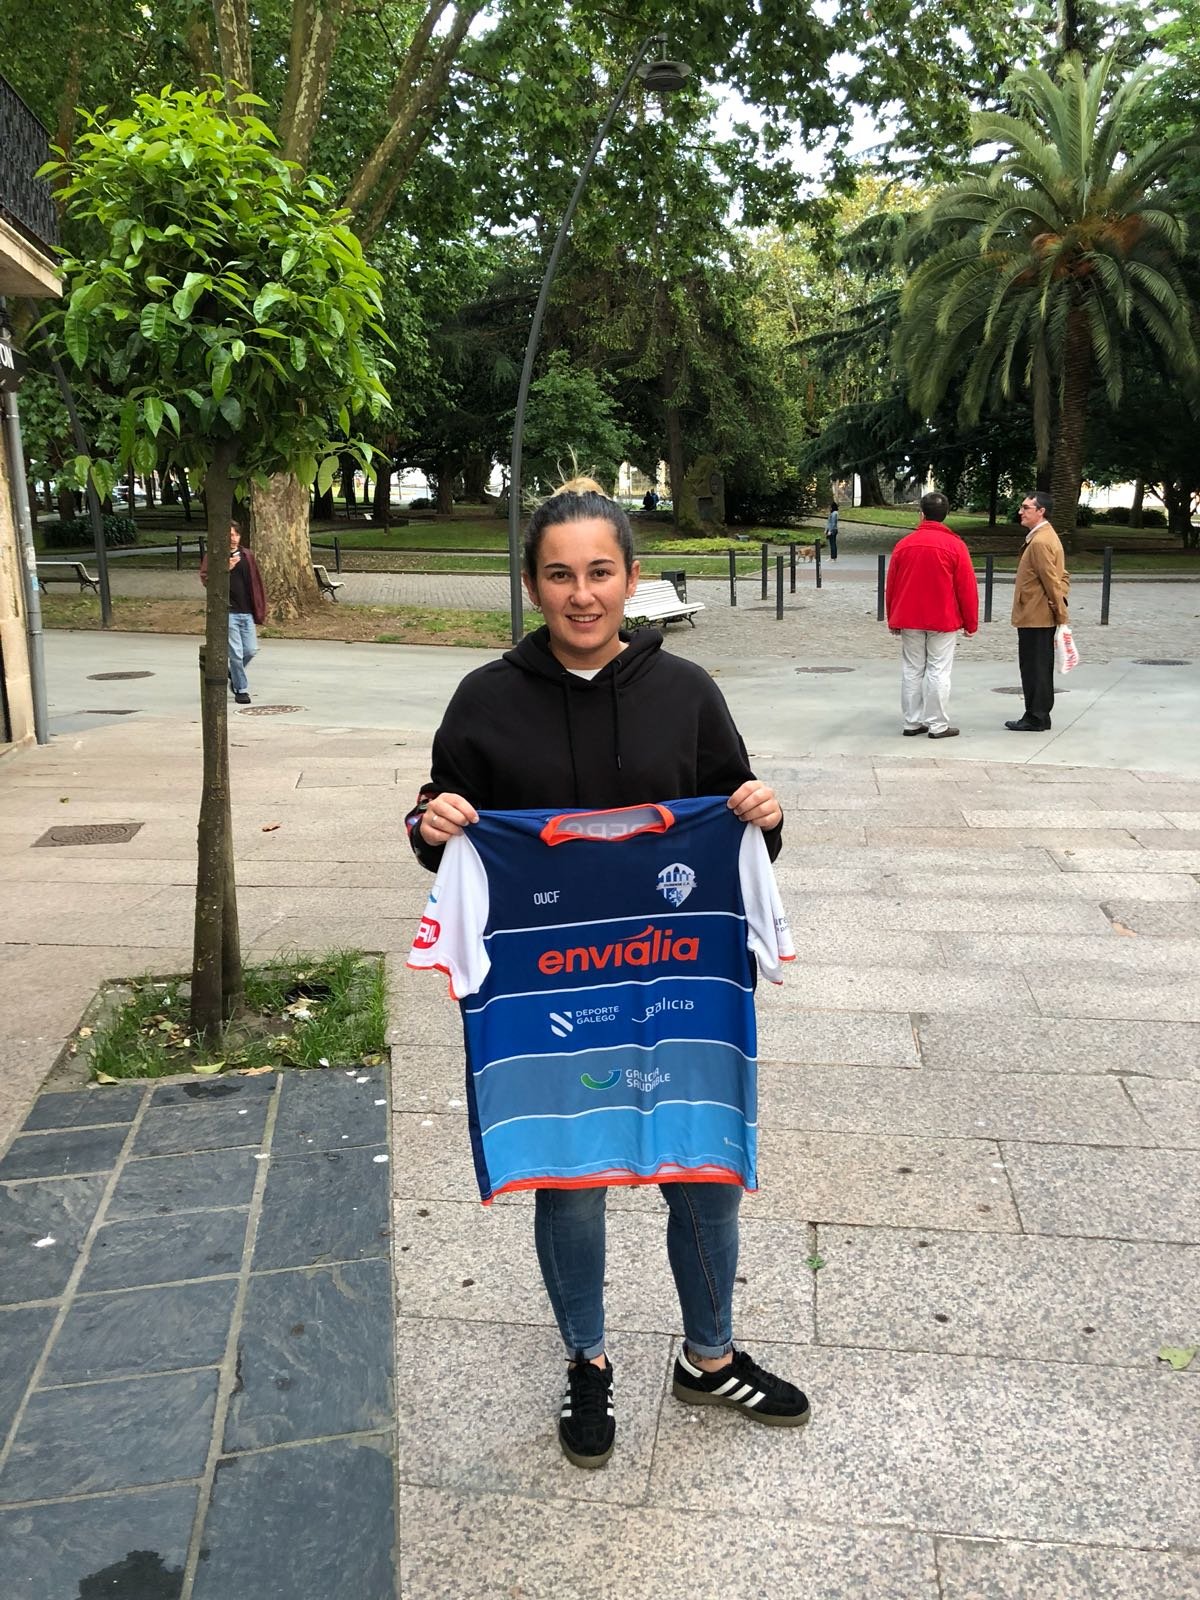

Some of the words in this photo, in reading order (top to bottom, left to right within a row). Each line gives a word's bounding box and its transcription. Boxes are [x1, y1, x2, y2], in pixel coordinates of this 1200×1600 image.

[533, 891, 560, 905] OUCF
[576, 1005, 620, 1017] DEPORTE
[632, 997, 694, 1022] galicia
[576, 1014, 616, 1025] GALEGO
[625, 1067, 660, 1083] GALICIA
[627, 1073, 671, 1092] SAUDABLE
